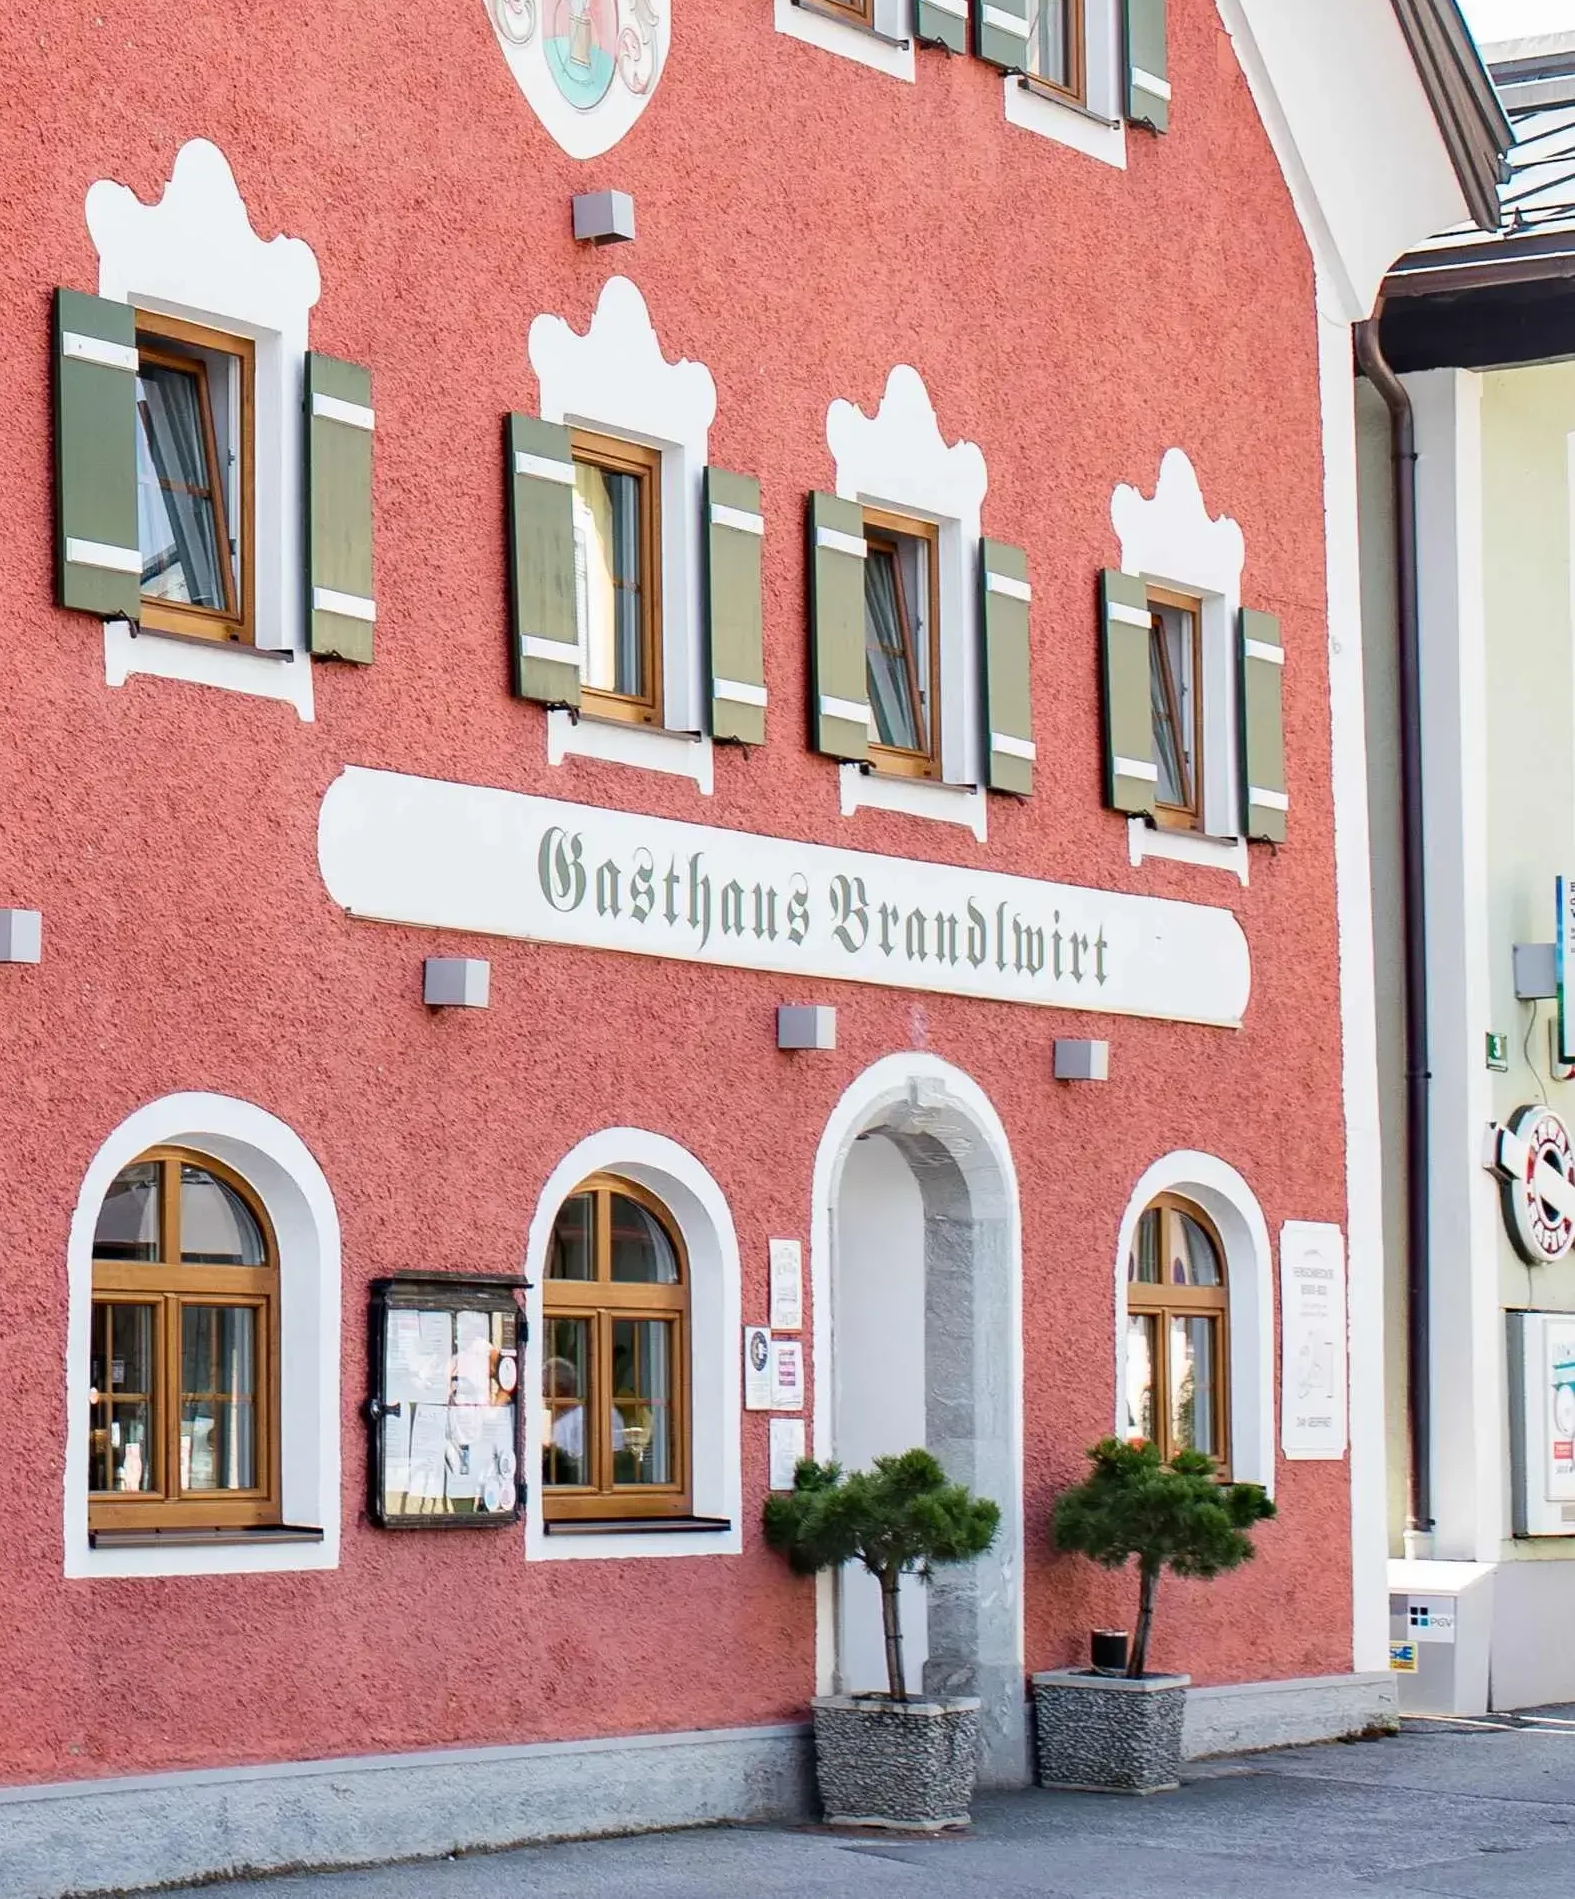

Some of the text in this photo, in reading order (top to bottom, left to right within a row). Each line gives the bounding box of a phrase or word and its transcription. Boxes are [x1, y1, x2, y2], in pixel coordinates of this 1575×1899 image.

[537, 825, 1112, 986] Gasthaus Brandlwirt
[1492, 1035, 1503, 1058] 3
